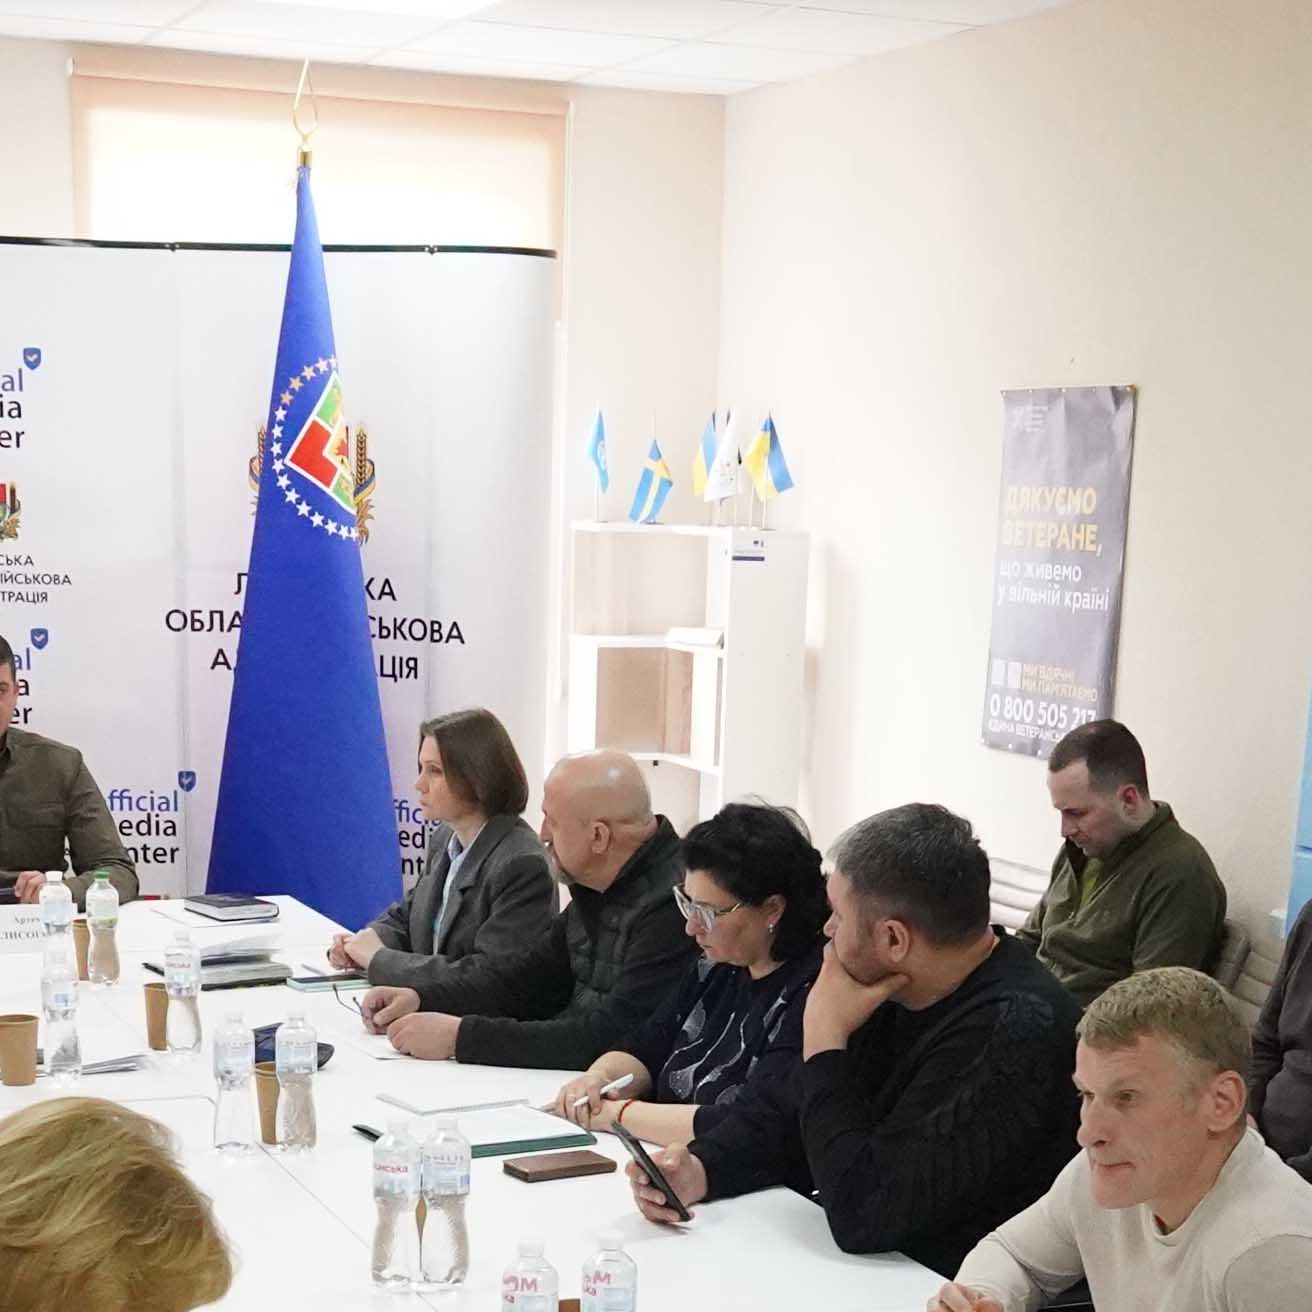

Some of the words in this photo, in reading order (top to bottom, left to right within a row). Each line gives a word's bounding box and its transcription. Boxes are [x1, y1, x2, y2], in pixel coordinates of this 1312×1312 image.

[165, 608, 243, 633] ОБЛА
[990, 694, 1001, 718] 0
[1004, 696, 1034, 723] 800
[1038, 701, 1068, 729] 505
[107, 789, 178, 814] fficial
[118, 813, 177, 837] edia
[128, 845, 179, 865] nter
